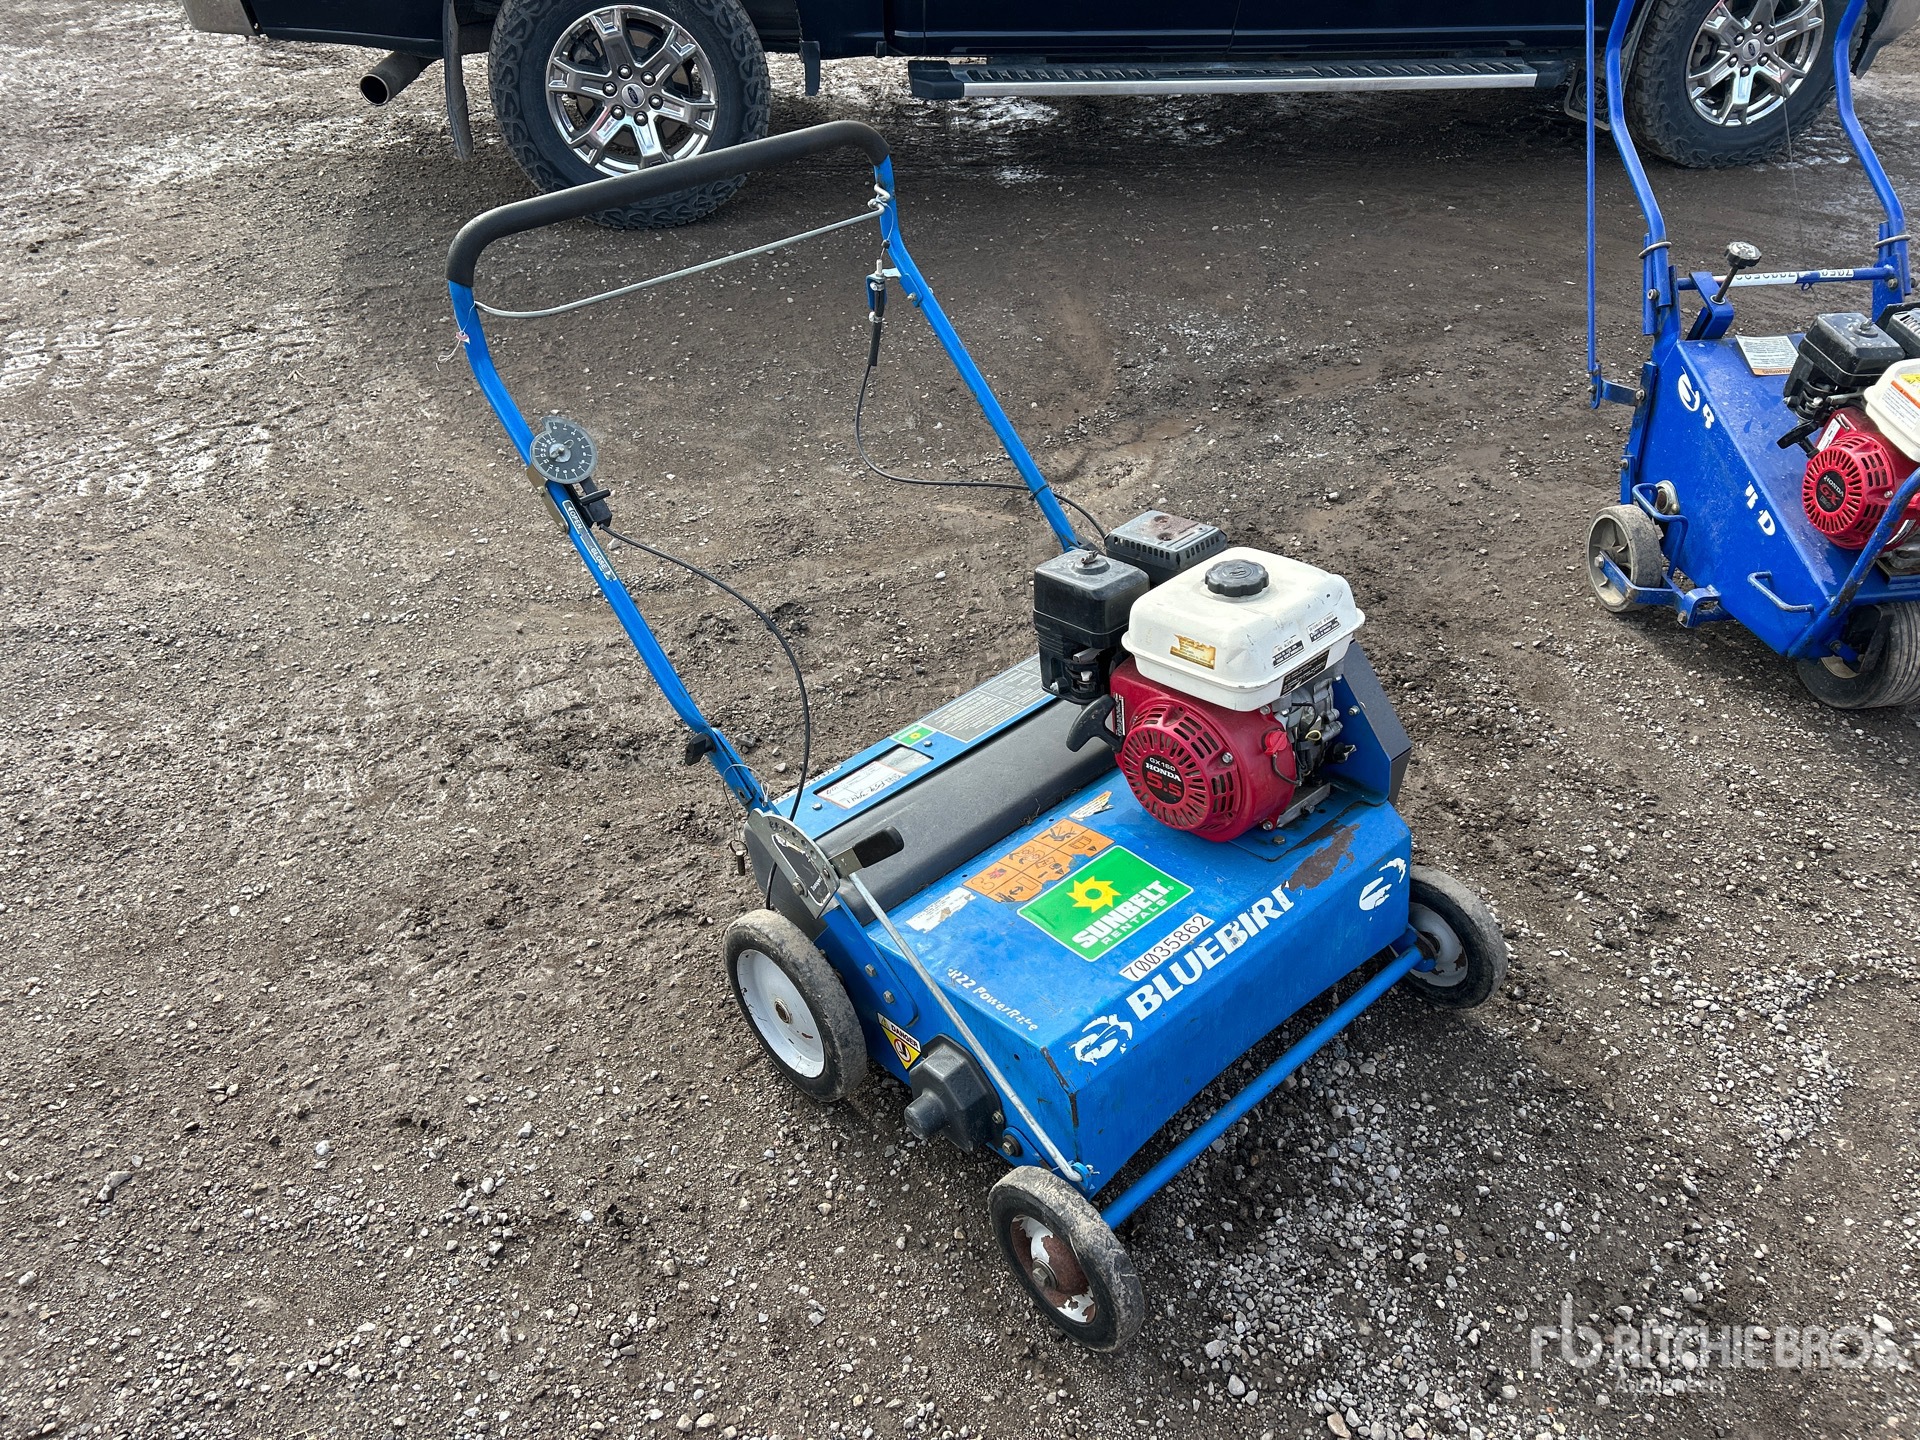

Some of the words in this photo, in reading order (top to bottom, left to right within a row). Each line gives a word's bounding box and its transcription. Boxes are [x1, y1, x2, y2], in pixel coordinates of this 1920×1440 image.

[1823, 475, 1845, 498] HONDA
[569, 510, 583, 530] OPEN
[590, 547, 608, 570] CLOSE
[1145, 762, 1182, 782] HONDA
[1149, 757, 1176, 772] GX160
[1146, 771, 1182, 797] 5.5
[1072, 880, 1170, 949] SUNBELT
[1101, 899, 1168, 945] RENTALS
[1122, 915, 1212, 979] 70035862
[891, 1024, 919, 1047] DANGER
